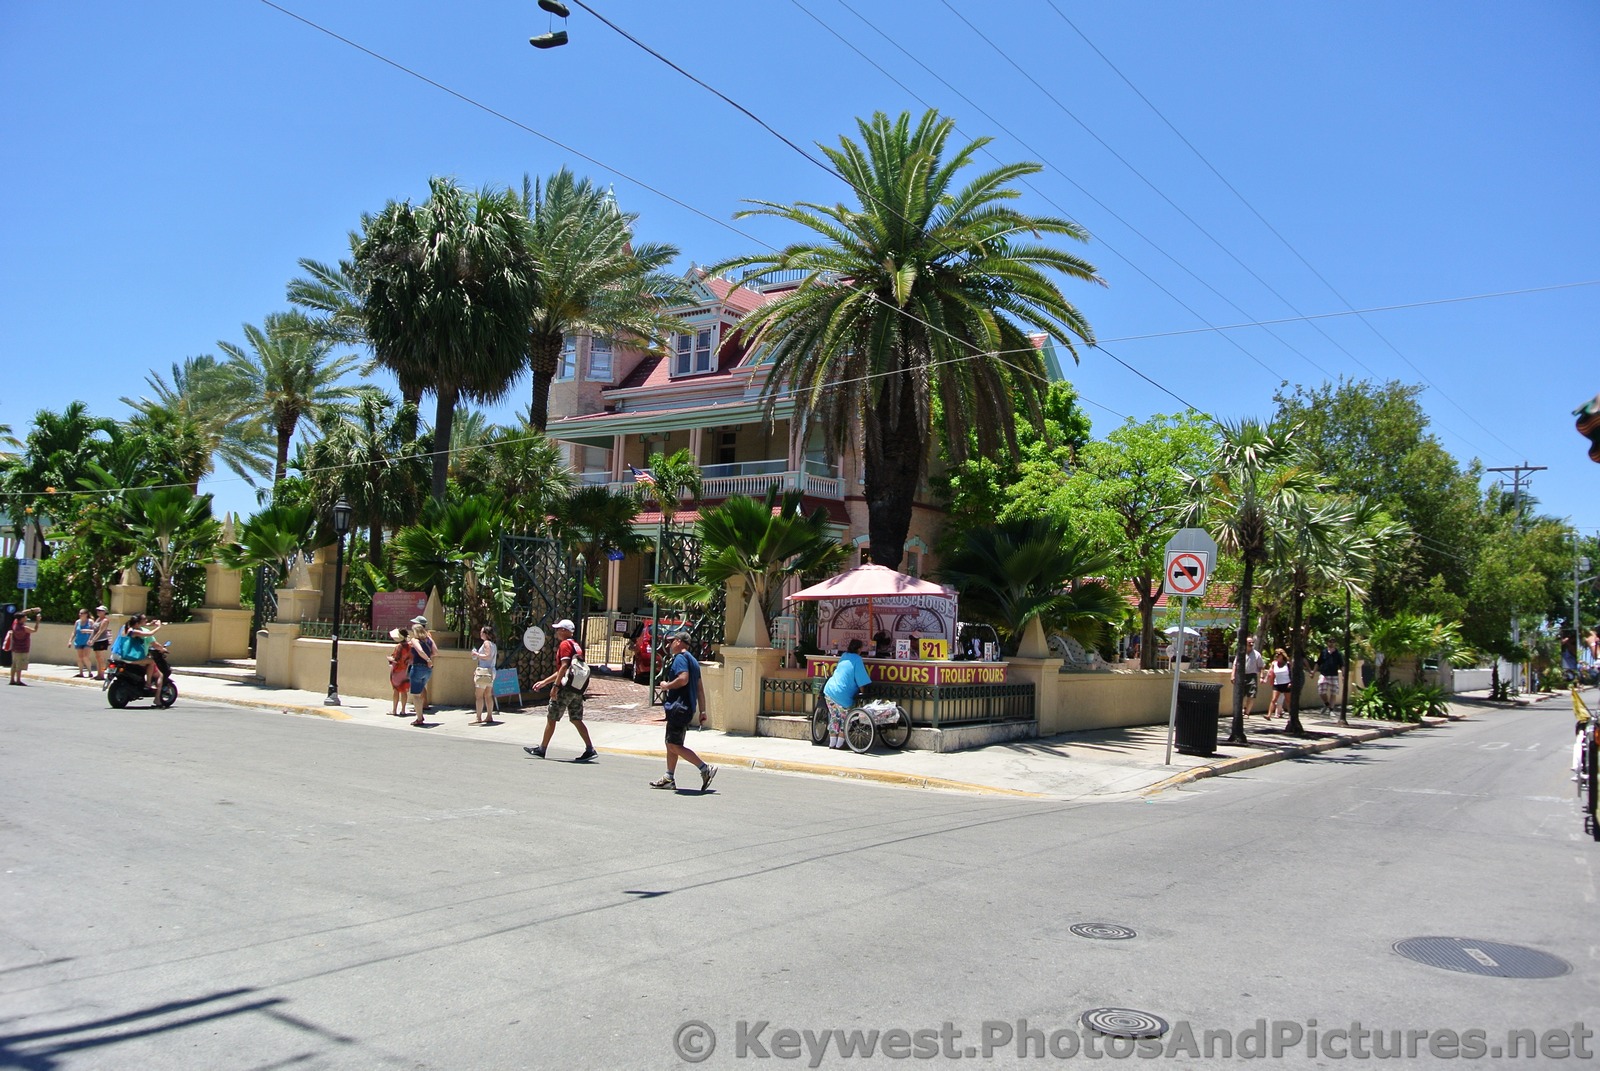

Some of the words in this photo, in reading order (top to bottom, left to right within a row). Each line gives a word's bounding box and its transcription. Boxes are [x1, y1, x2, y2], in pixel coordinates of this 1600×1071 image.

[916, 594, 955, 619] HOUSE
[878, 664, 930, 683] TOURS
[940, 668, 977, 684] TROLLEY
[978, 668, 1005, 683] TOURS
